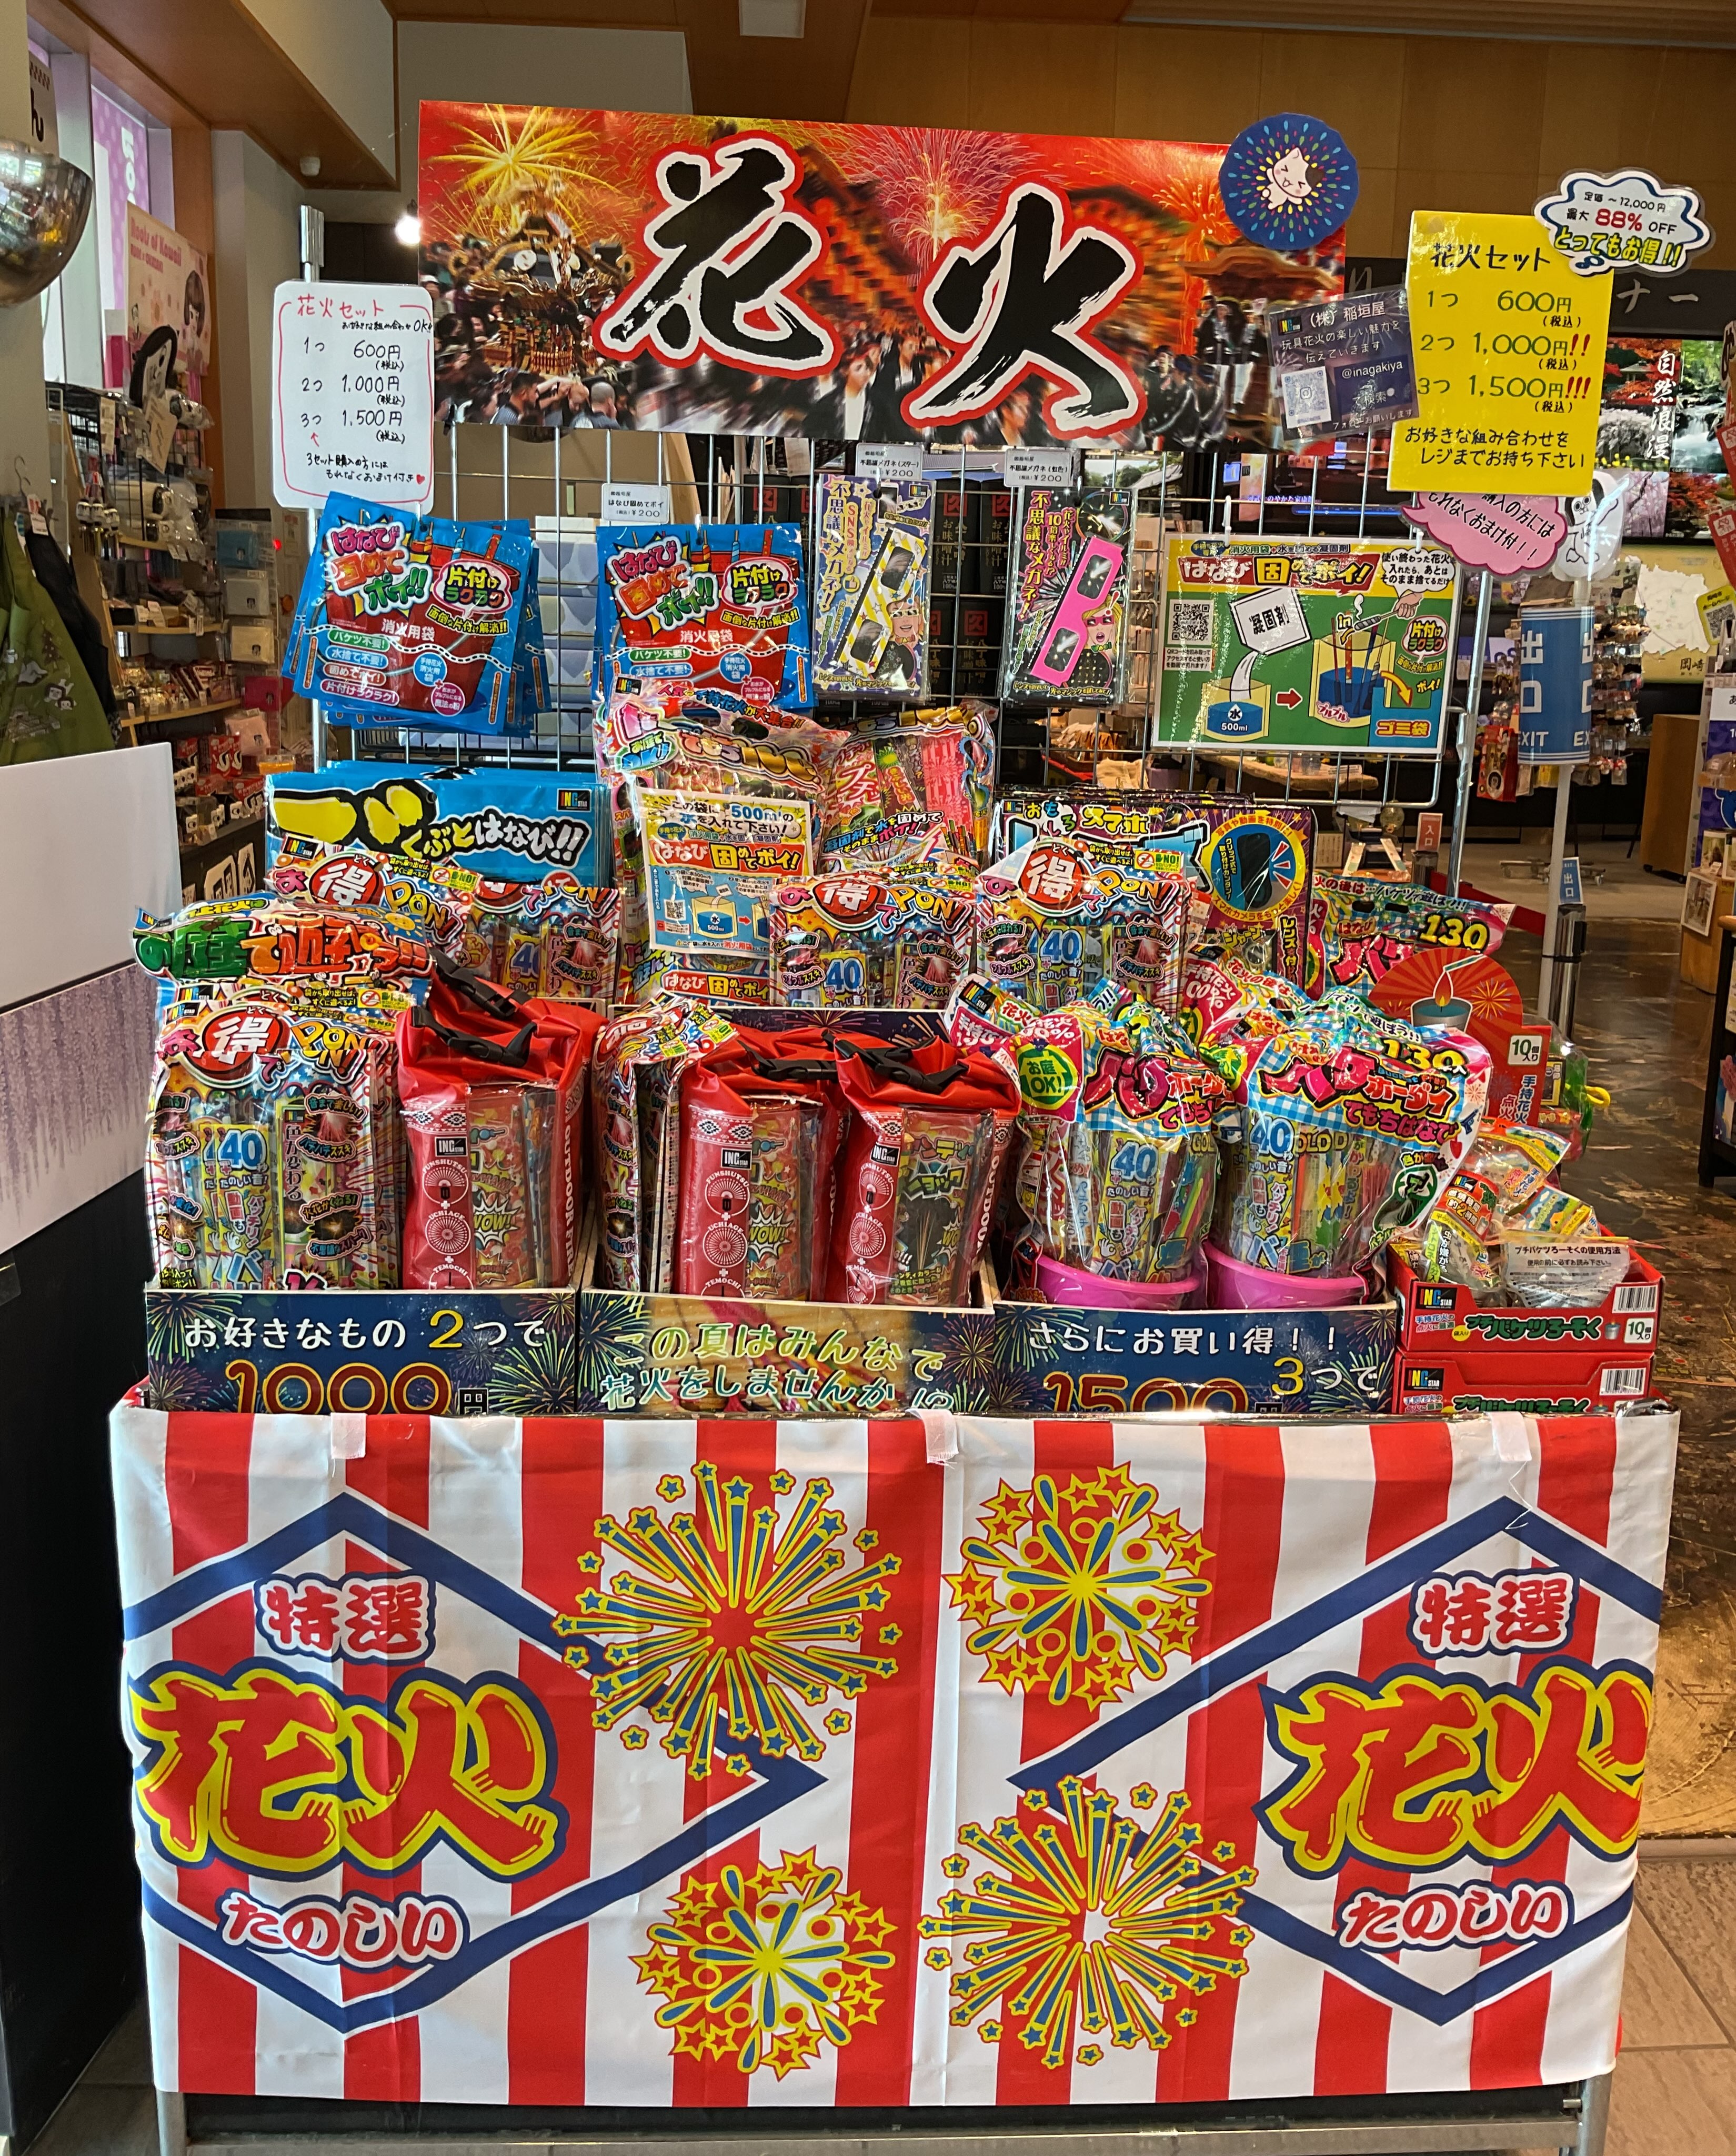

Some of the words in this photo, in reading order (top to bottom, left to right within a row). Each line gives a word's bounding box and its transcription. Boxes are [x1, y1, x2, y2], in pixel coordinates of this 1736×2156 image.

[1584, 191, 1603, 203] 定価
[1567, 207, 1589, 222] 最大
[1595, 208, 1642, 232] 88%
[1648, 222, 1677, 235] OFF
[1430, 243, 1550, 272] 花火セット
[598, 135, 1143, 435] 花火
[298, 295, 383, 318] 花火セット
[1343, 301, 1386, 321] 稲垣屋
[1428, 291, 1459, 308] 1つ
[1498, 291, 1571, 313] 600円
[1543, 316, 1581, 327] (税込)
[1281, 320, 1400, 351] 玩具花火の楽しい魅力を
[1420, 334, 1455, 351] 2つ
[304, 337, 325, 354] 1つ
[354, 340, 400, 360] 600円
[1306, 341, 1380, 364] 伝えていきます
[376, 360, 404, 371] (税込)
[1342, 361, 1403, 378] @inagakiya
[1539, 358, 1577, 371] (税込)
[302, 377, 323, 392] 2つ
[343, 374, 399, 393] 1,000円
[1417, 377, 1451, 395] 3つ
[377, 394, 405, 406] (税込)
[1534, 402, 1572, 413] (税込)
[1646, 350, 1677, 460] 自然浪漫
[301, 413, 321, 427] 3つ
[343, 410, 402, 427] 1,500円
[376, 431, 405, 444] (税込)
[1405, 426, 1569, 447] お好きな組み合わせを
[1420, 449, 1584, 468] レジまでお持ち下さい
[330, 527, 400, 556] はなび
[615, 540, 678, 580] はなび
[1019, 491, 1050, 621] 不思議なメガネ!
[448, 566, 499, 589] 片付け
[732, 566, 781, 588] 片付け
[444, 588, 504, 606] ラクラク
[734, 585, 788, 603] ラクラク
[1249, 604, 1289, 635] 凝固剤
[1338, 615, 1352, 629] in
[382, 618, 435, 643] 消火用袋
[1411, 621, 1441, 638] 片付け
[334, 631, 385, 650] バケツ不要!
[1409, 637, 1443, 651] ラクラク
[331, 650, 384, 667] 水捨て不要!
[635, 648, 687, 660] バケツ不要!
[635, 665, 688, 676] 水捨て不要!
[1417, 678, 1441, 694] ポイ!
[1230, 709, 1241, 719] 水
[1221, 723, 1248, 732] 500ml
[1377, 721, 1431, 737] ゴミ袋
[561, 792, 578, 807] INC
[1081, 806, 1149, 835] スマホ
[655, 843, 800, 869] はなび固めてポイ!
[1563, 874, 1574, 898] 出口
[1420, 913, 1489, 952] 130
[1041, 930, 1082, 964] 40
[827, 959, 863, 992] 40
[1027, 1060, 1056, 1076] お庭
[1030, 1076, 1062, 1095] OK!
[1514, 1074, 1537, 1124] 手持花火
[439, 1140, 455, 1152] INC
[1250, 1116, 1294, 1157] 40
[220, 1128, 265, 1170] 40
[724, 1151, 739, 1165] INC
[423, 1159, 467, 1174] FUNSHUTSU
[1111, 1141, 1157, 1182] 40
[220, 1173, 267, 1186] たのしい音!
[564, 1124, 575, 1224] OUTDOOR
[705, 1171, 750, 1189] FUNSHUTSU
[428, 1210, 465, 1221] UCHIAGE
[708, 1222, 744, 1234] UCHIAGE
[565, 1229, 575, 1276] FIRE
[1514, 1245, 1621, 1255] プチバケツろーそくの使用方法
[433, 1264, 468, 1276] TEMOCHI
[705, 1276, 742, 1291] TEMOCHI
[1420, 1289, 1441, 1306] INC
[1416, 1313, 1454, 1324] 手持花火の
[1416, 1321, 1454, 1333] 点火に最適
[1465, 1314, 1602, 1341] プチバケツろーそく
[613, 1322, 947, 1382] この夏はみんなで
[1272, 1356, 1379, 1395] 3つで
[1408, 1370, 1428, 1386] INC
[260, 1578, 432, 1661] 特選
[1416, 1573, 1576, 1654] 特選
[135, 1670, 563, 1878] 花火
[1268, 1666, 1651, 1871] 花火
[1340, 1883, 1570, 1949] たのしい
[221, 1892, 464, 1964] たのしい
